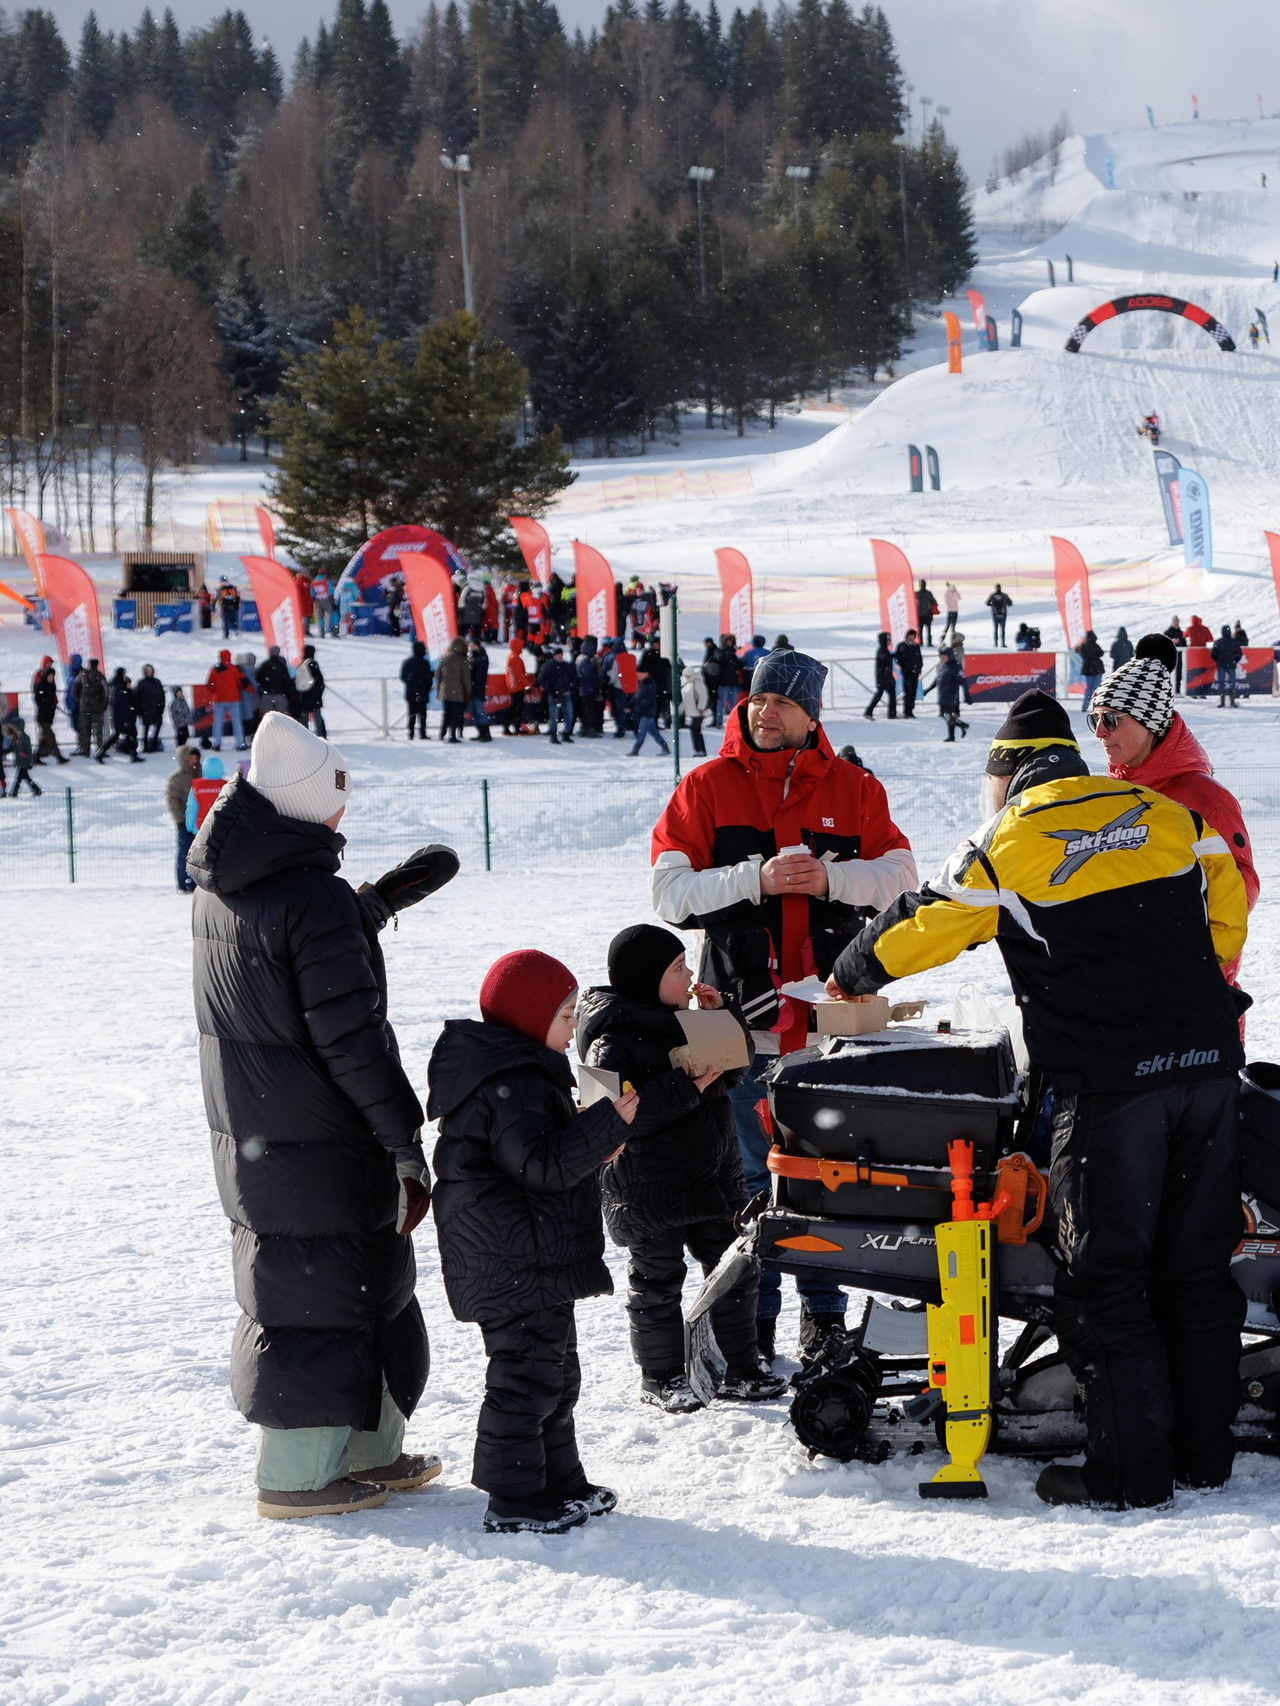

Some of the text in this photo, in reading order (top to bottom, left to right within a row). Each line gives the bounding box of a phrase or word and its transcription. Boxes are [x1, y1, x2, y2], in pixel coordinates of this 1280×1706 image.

[976, 675, 1040, 684] COMPOSIT
[1065, 824, 1149, 856] ski-doo
[1096, 837, 1149, 854] TEAM
[1135, 1048, 1220, 1077] ski-doo
